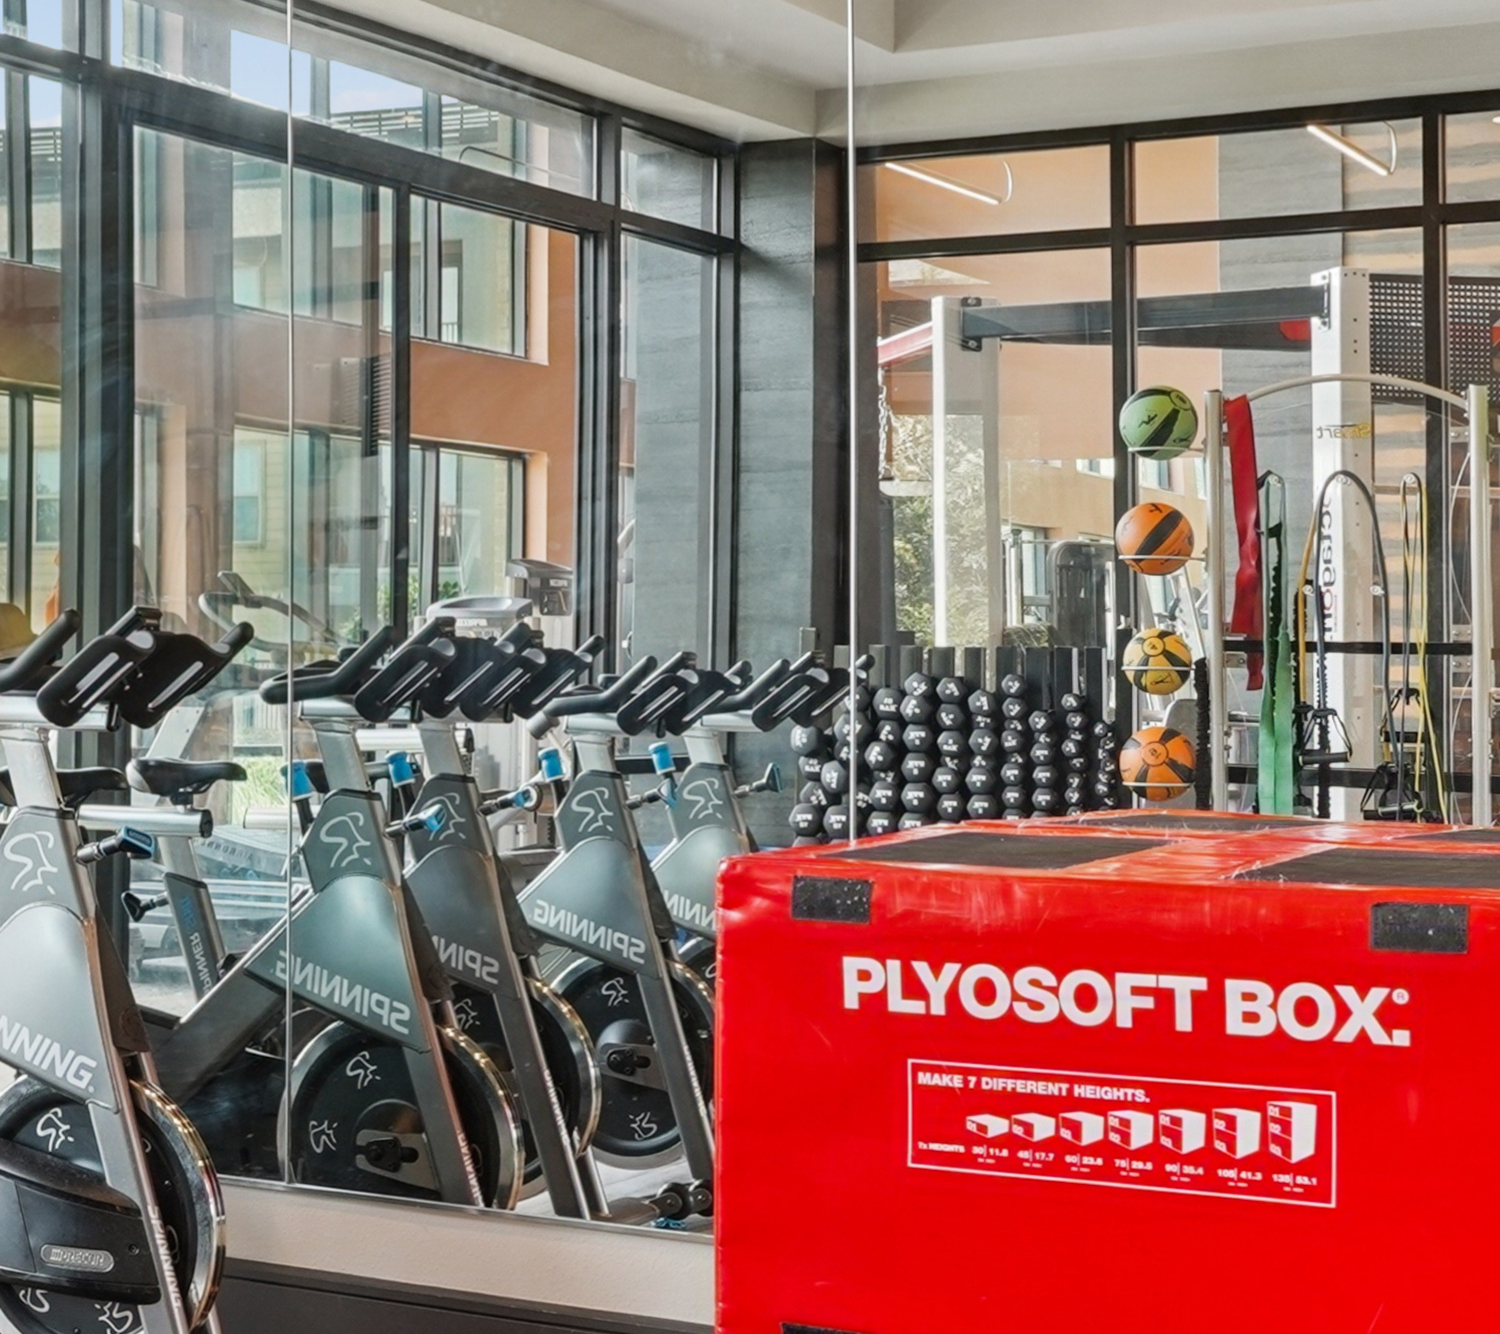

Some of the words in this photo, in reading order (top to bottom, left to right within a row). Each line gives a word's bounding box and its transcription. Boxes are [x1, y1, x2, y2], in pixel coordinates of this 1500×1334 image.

[842, 955, 1208, 1032] PLYOSOFT
[917, 1071, 964, 1089] MAKE
[967, 1075, 977, 1090] 7
[981, 1076, 1070, 1097] DIFFERENT
[1073, 1083, 1151, 1104] HEIGHTS.
